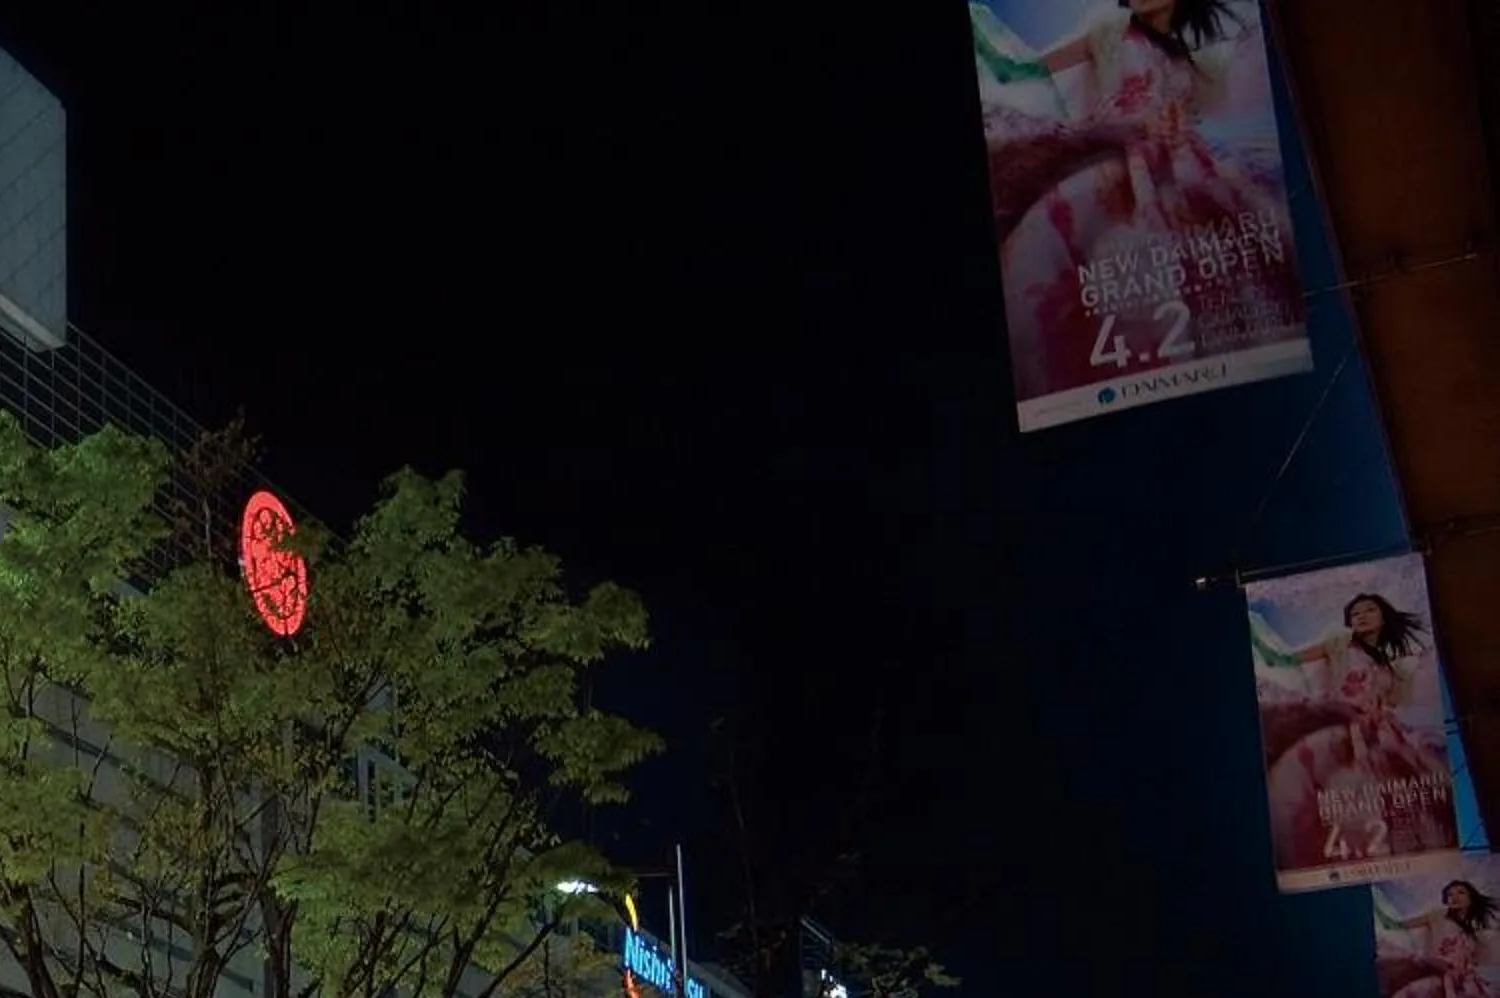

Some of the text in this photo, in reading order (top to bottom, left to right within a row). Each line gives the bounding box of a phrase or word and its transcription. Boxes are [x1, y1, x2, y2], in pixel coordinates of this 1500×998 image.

[1077, 252, 1140, 285] NEW
[1080, 235, 1285, 308] GRAND OPEN
[1089, 300, 1197, 369] 4.2
[1323, 820, 1391, 860] 4.2
